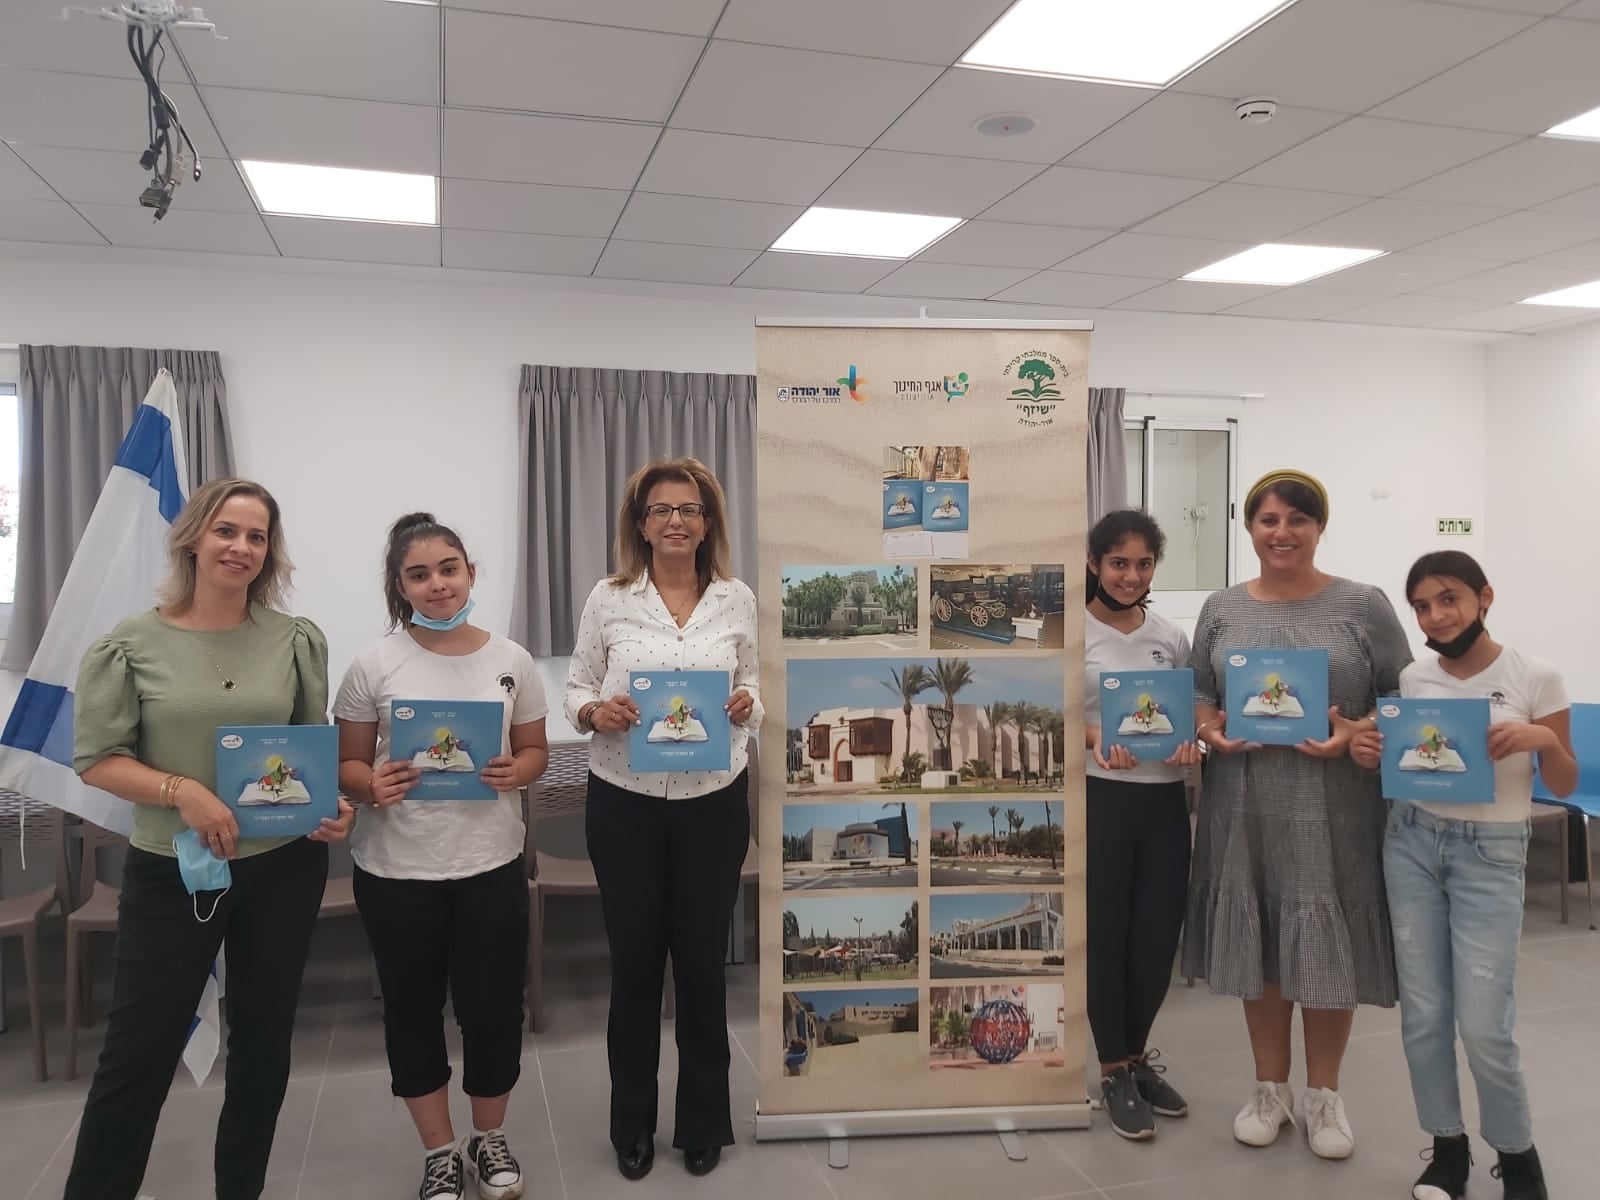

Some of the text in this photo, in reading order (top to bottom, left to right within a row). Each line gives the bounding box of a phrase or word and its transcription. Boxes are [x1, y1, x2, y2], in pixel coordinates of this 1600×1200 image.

[791, 387, 840, 396] אור יהודה
[893, 380, 941, 394] אגף החינוך
[1439, 520, 1472, 533] שרותים
